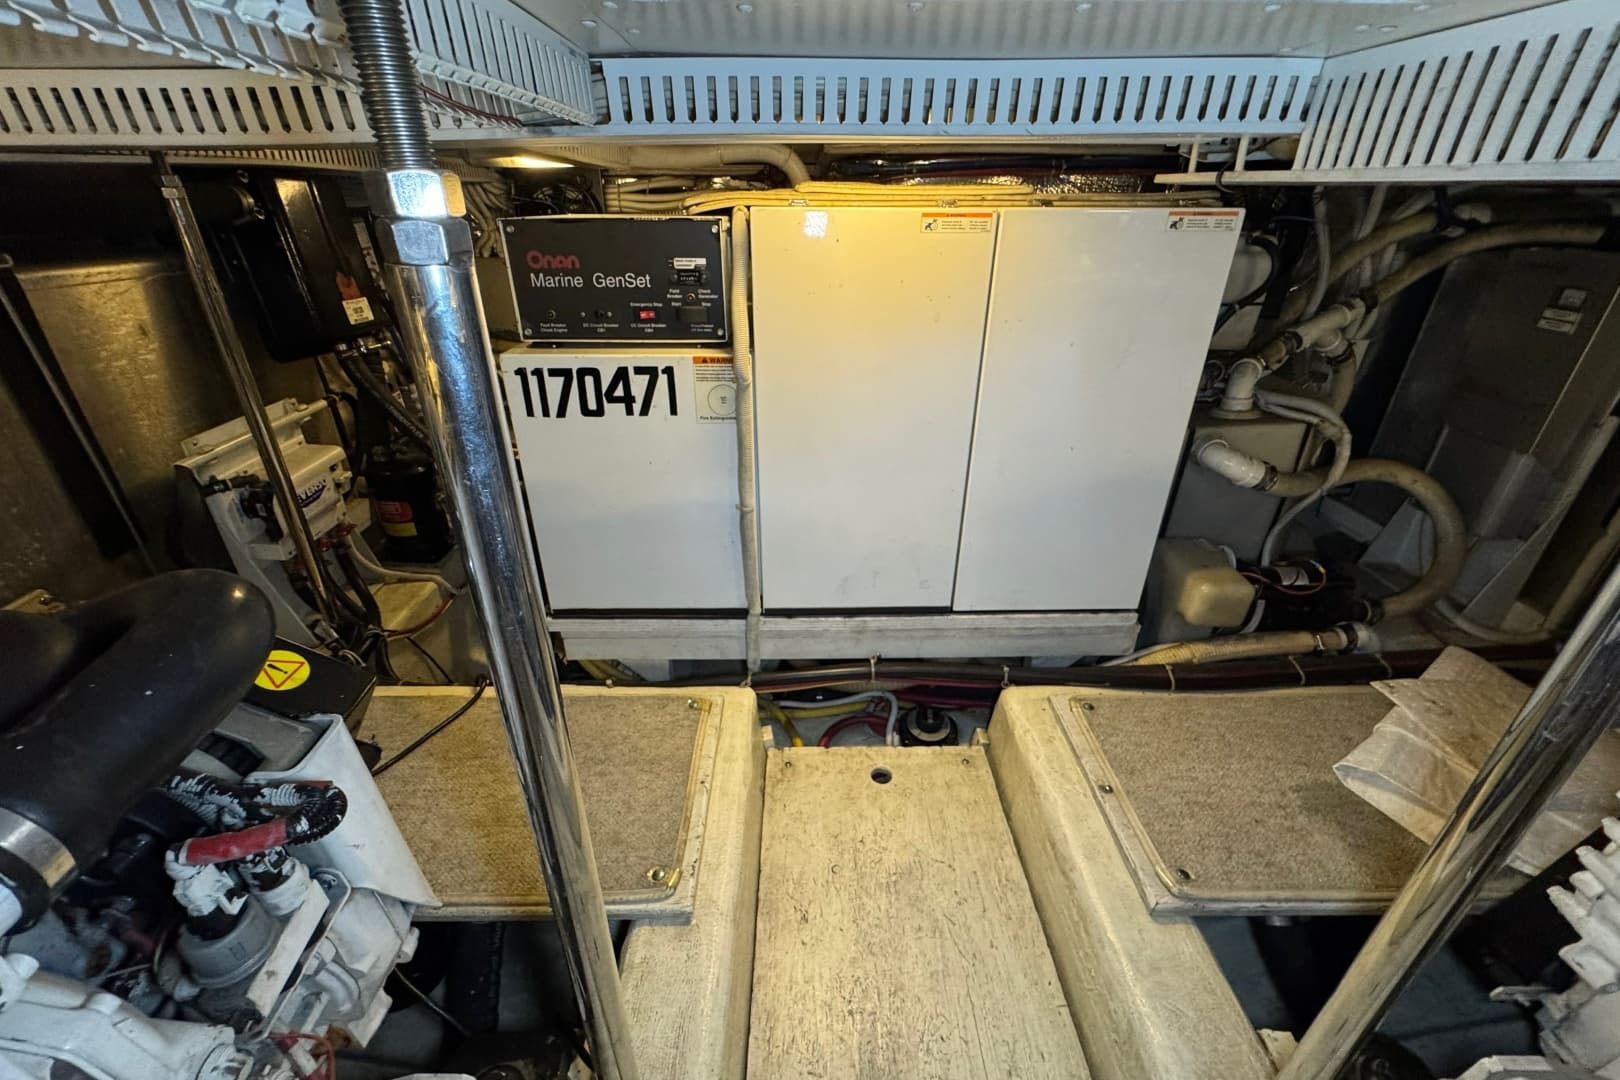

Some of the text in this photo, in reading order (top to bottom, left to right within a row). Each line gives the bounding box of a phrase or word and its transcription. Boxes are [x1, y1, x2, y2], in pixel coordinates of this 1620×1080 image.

[527, 250, 580, 269] Onan
[530, 272, 652, 288] Marine GenSet
[709, 357, 734, 365] WARN
[513, 365, 679, 419] 1170471
